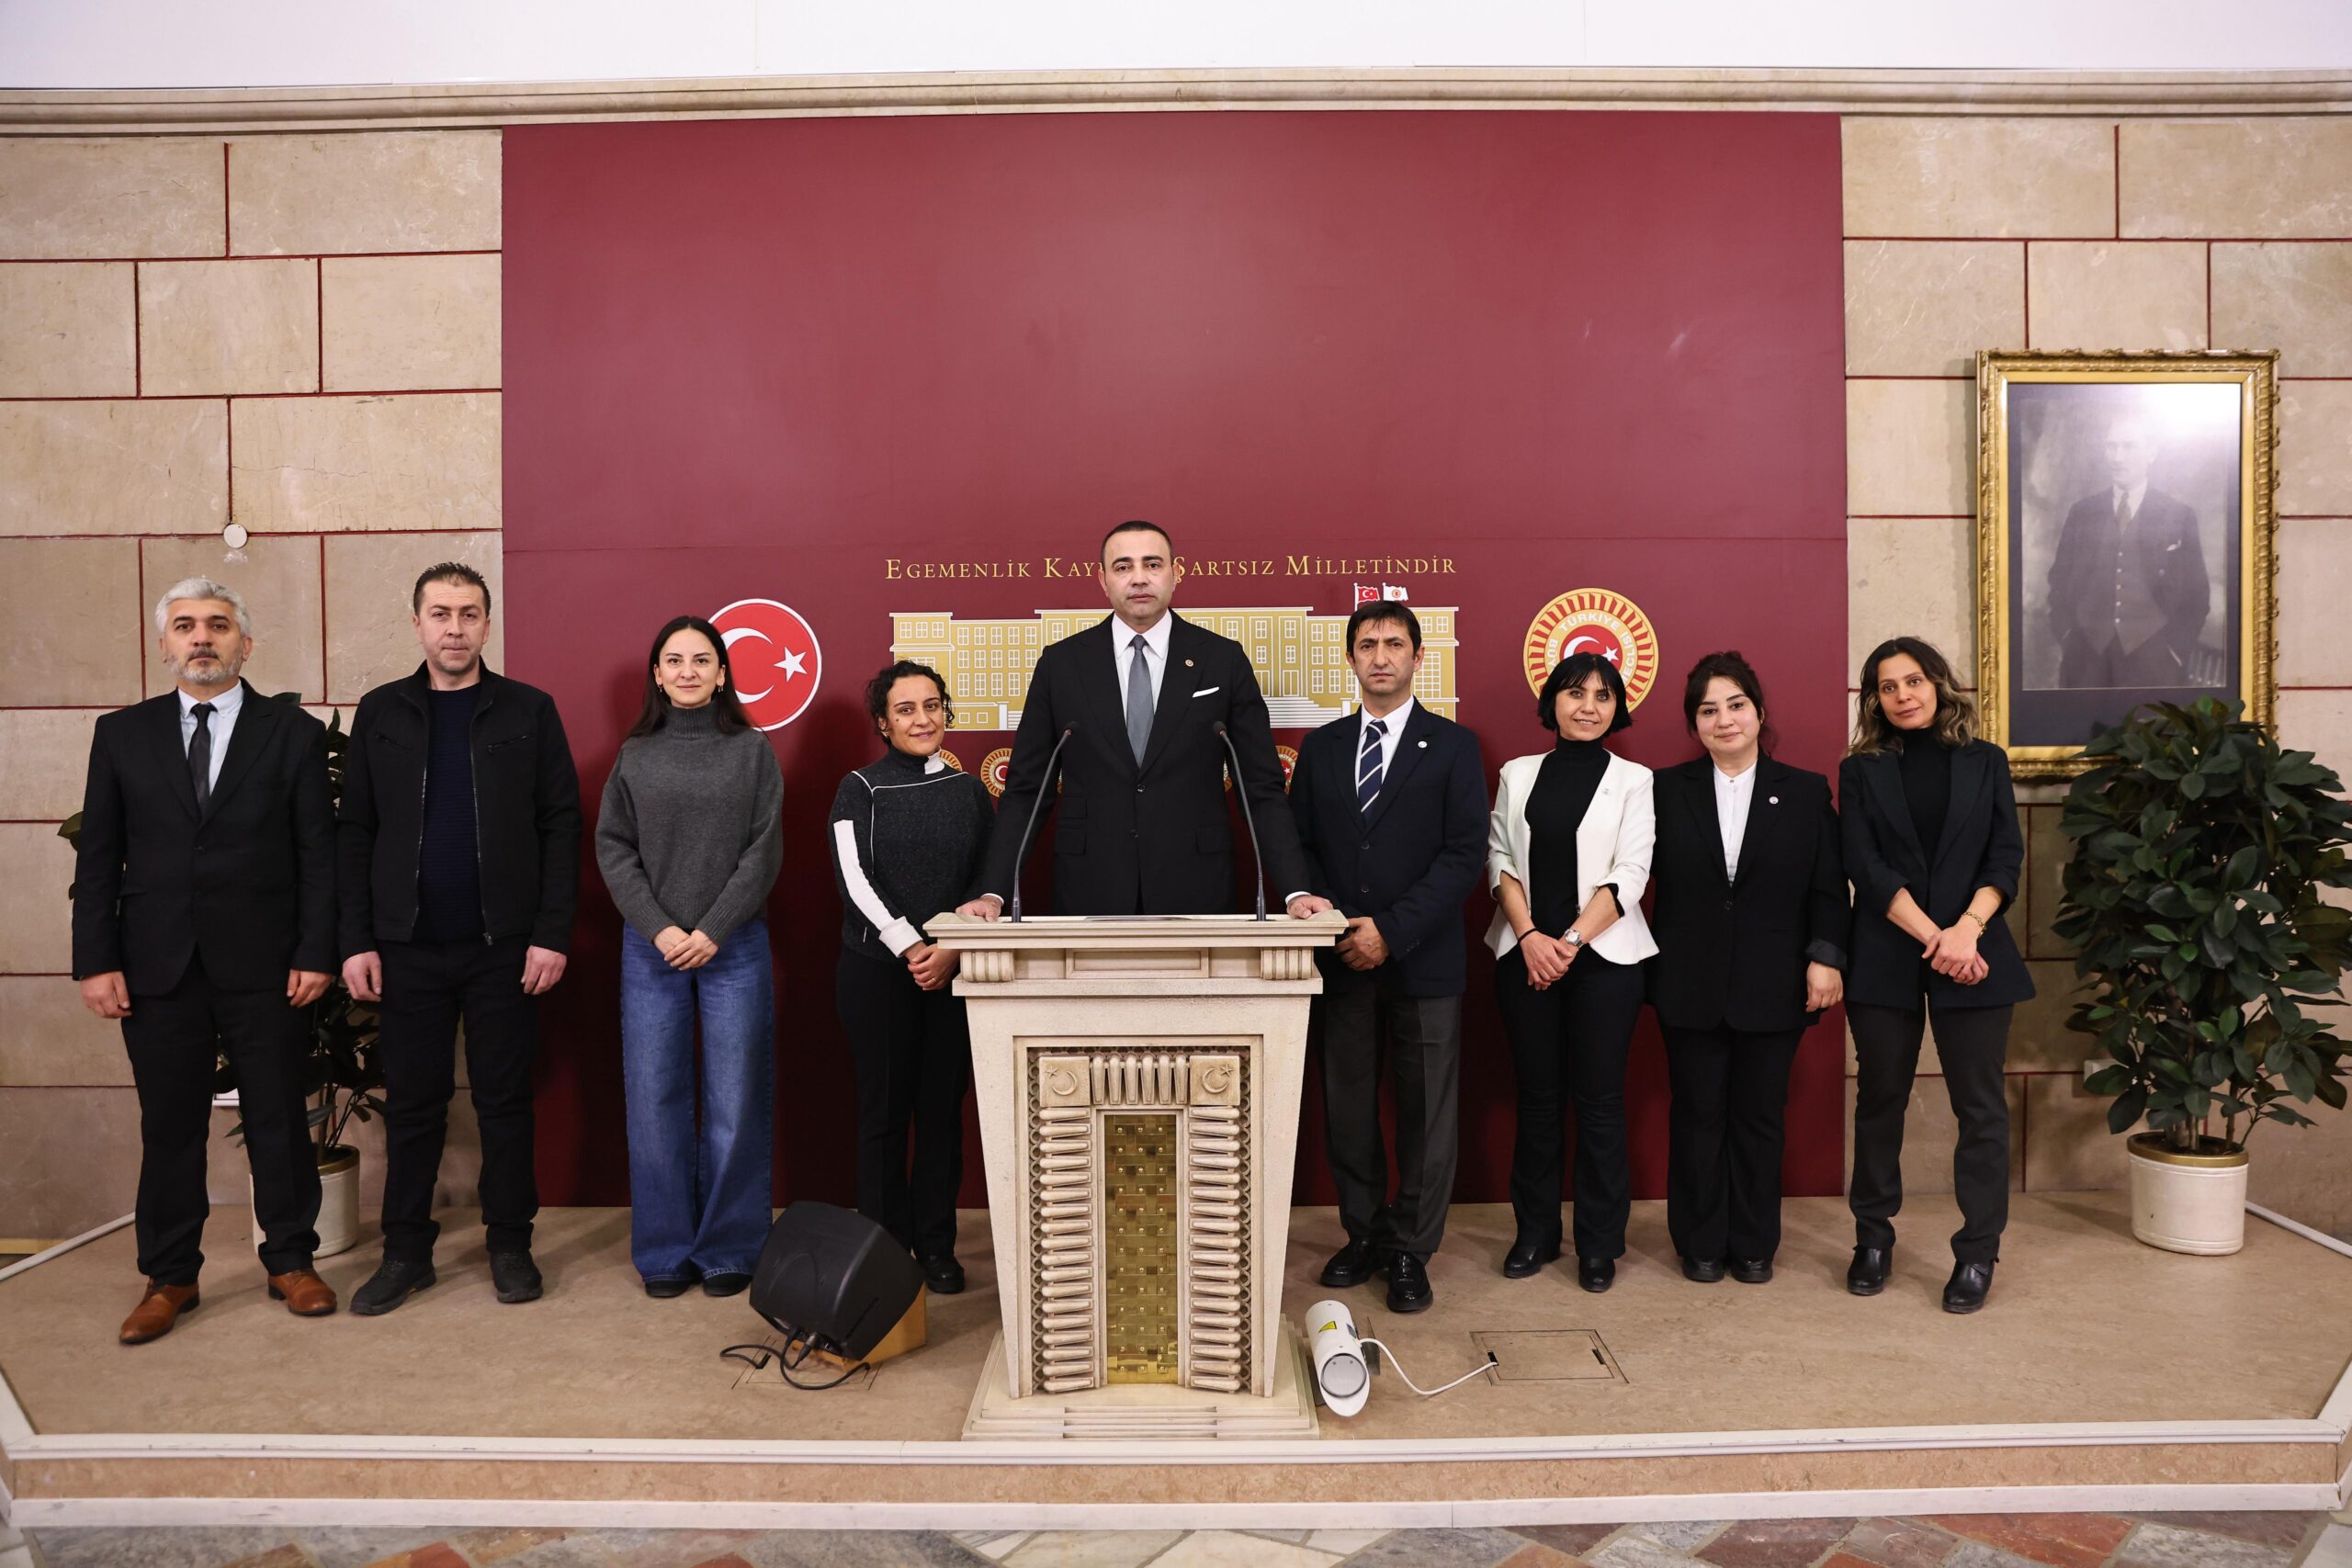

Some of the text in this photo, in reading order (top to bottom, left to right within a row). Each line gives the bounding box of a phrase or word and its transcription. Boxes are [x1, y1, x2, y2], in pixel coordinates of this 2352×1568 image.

[885, 558, 1032, 580] EGEMENLİK
[1285, 555, 1456, 575] MİLLETİNDİR
[1559, 613, 1621, 632] TÜRKİYE
[1547, 638, 1559, 668] BÜY
